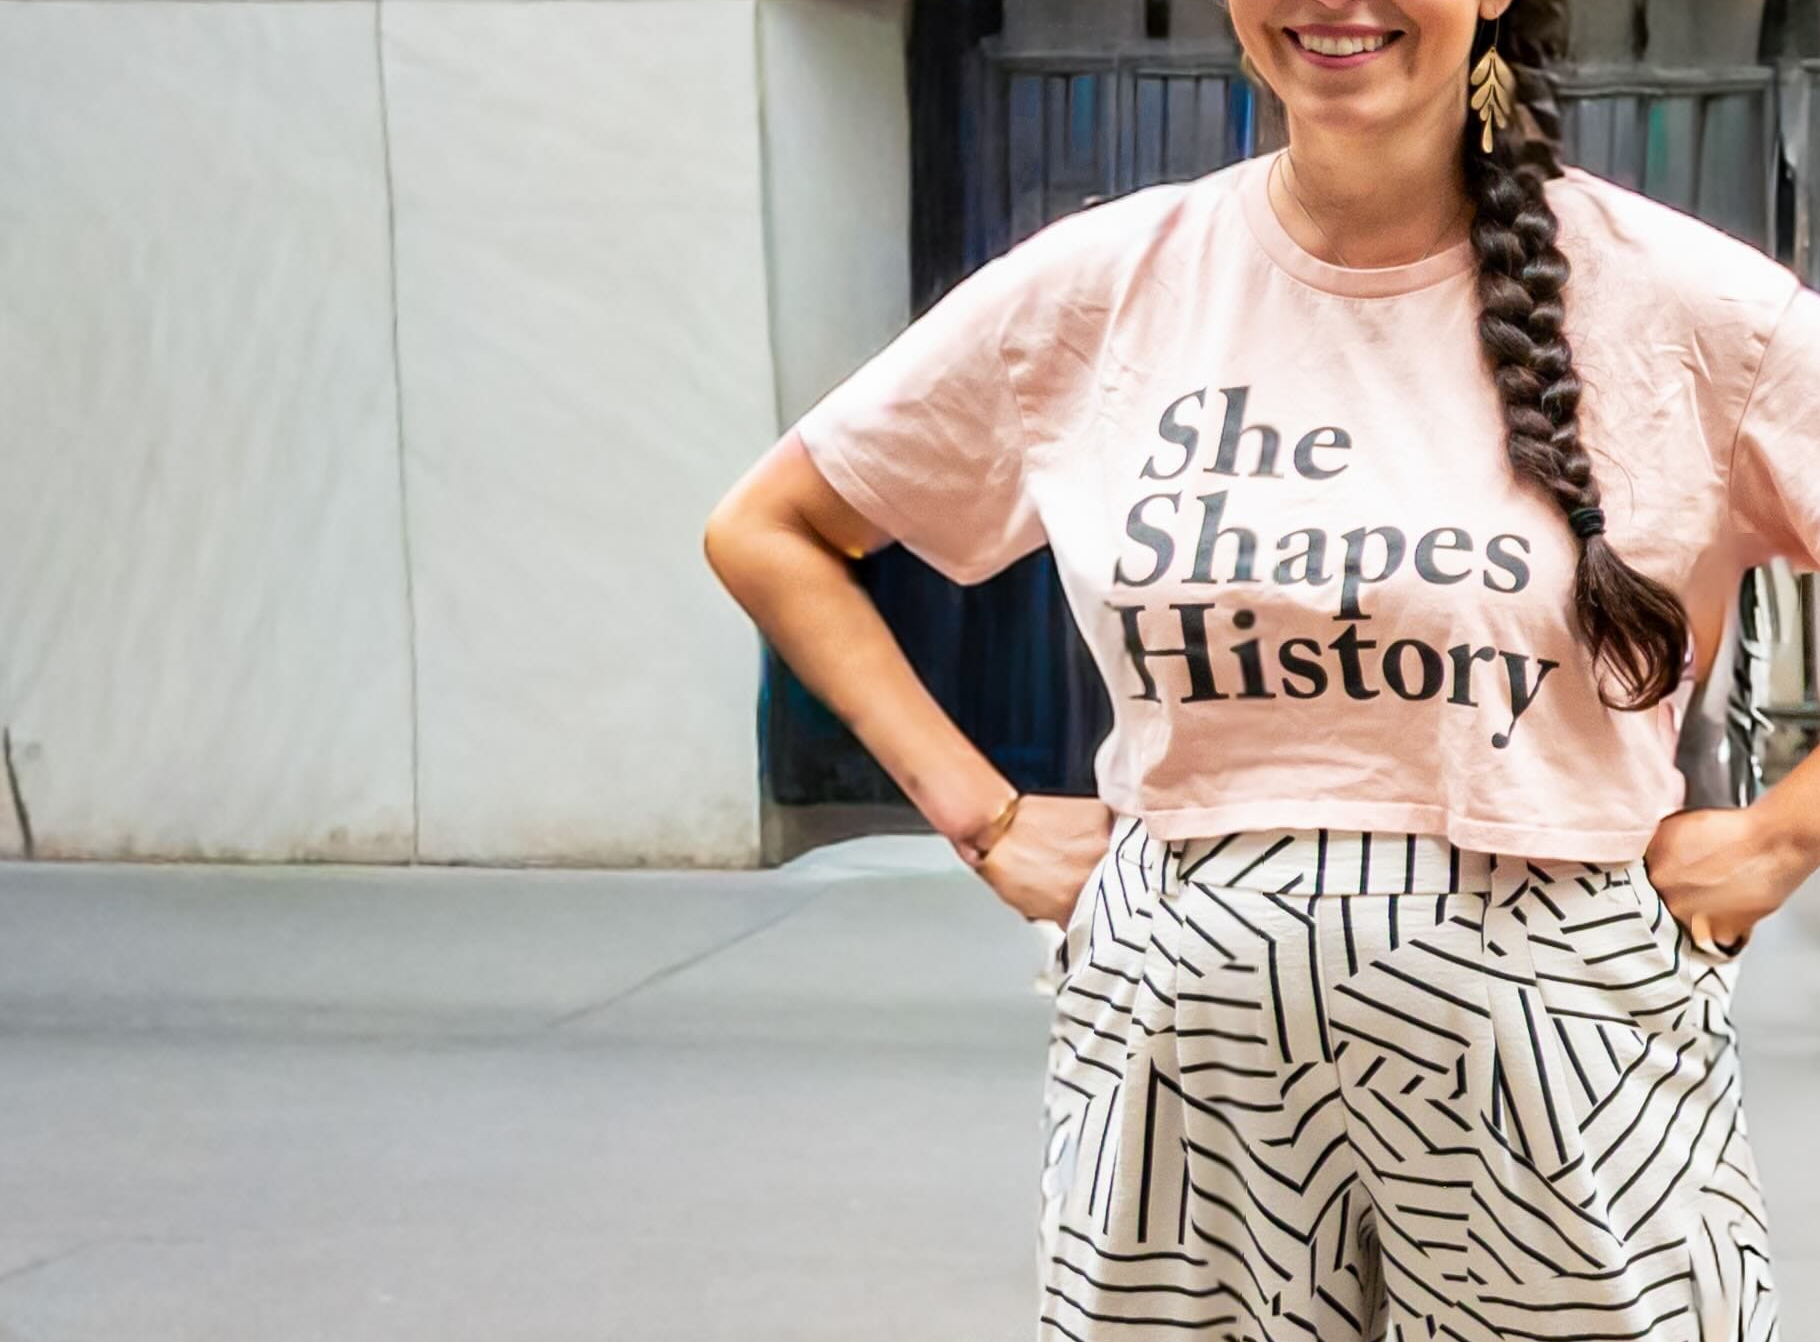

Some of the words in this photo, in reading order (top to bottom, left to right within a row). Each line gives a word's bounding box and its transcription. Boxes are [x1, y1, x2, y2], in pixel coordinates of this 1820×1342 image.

[1140, 385, 1352, 480] She
[1113, 490, 1532, 621] Shapes
[1104, 601, 1560, 749] History
